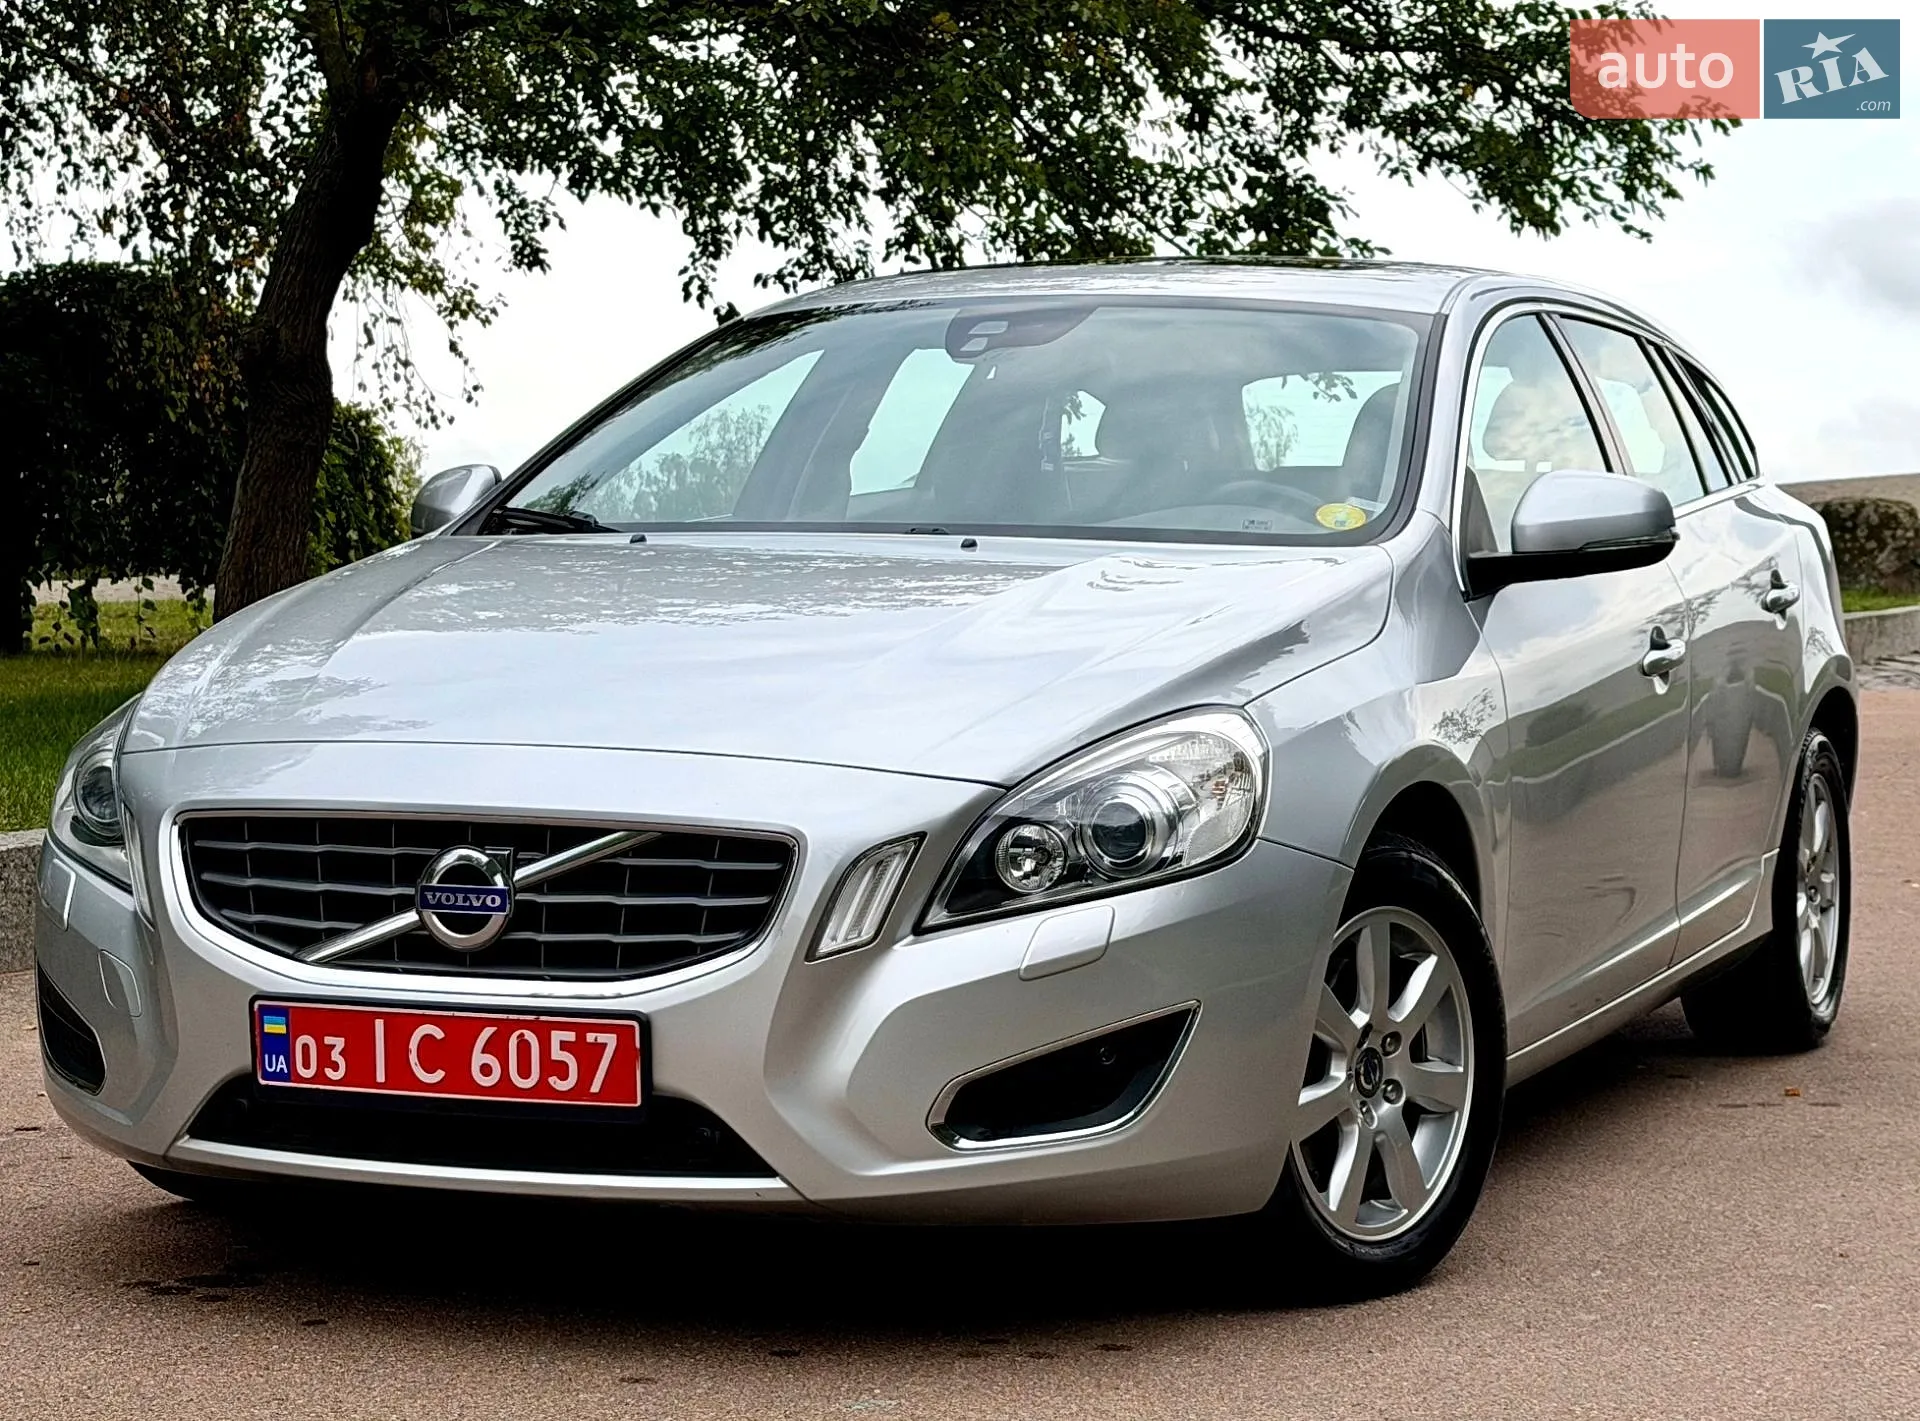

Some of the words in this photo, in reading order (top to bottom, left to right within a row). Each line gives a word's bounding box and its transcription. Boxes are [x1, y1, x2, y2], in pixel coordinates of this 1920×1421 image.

[423, 891, 502, 908] VOLVO
[264, 1053, 289, 1074] UA
[294, 1034, 347, 1081] 03
[470, 1026, 618, 1094] 6057
